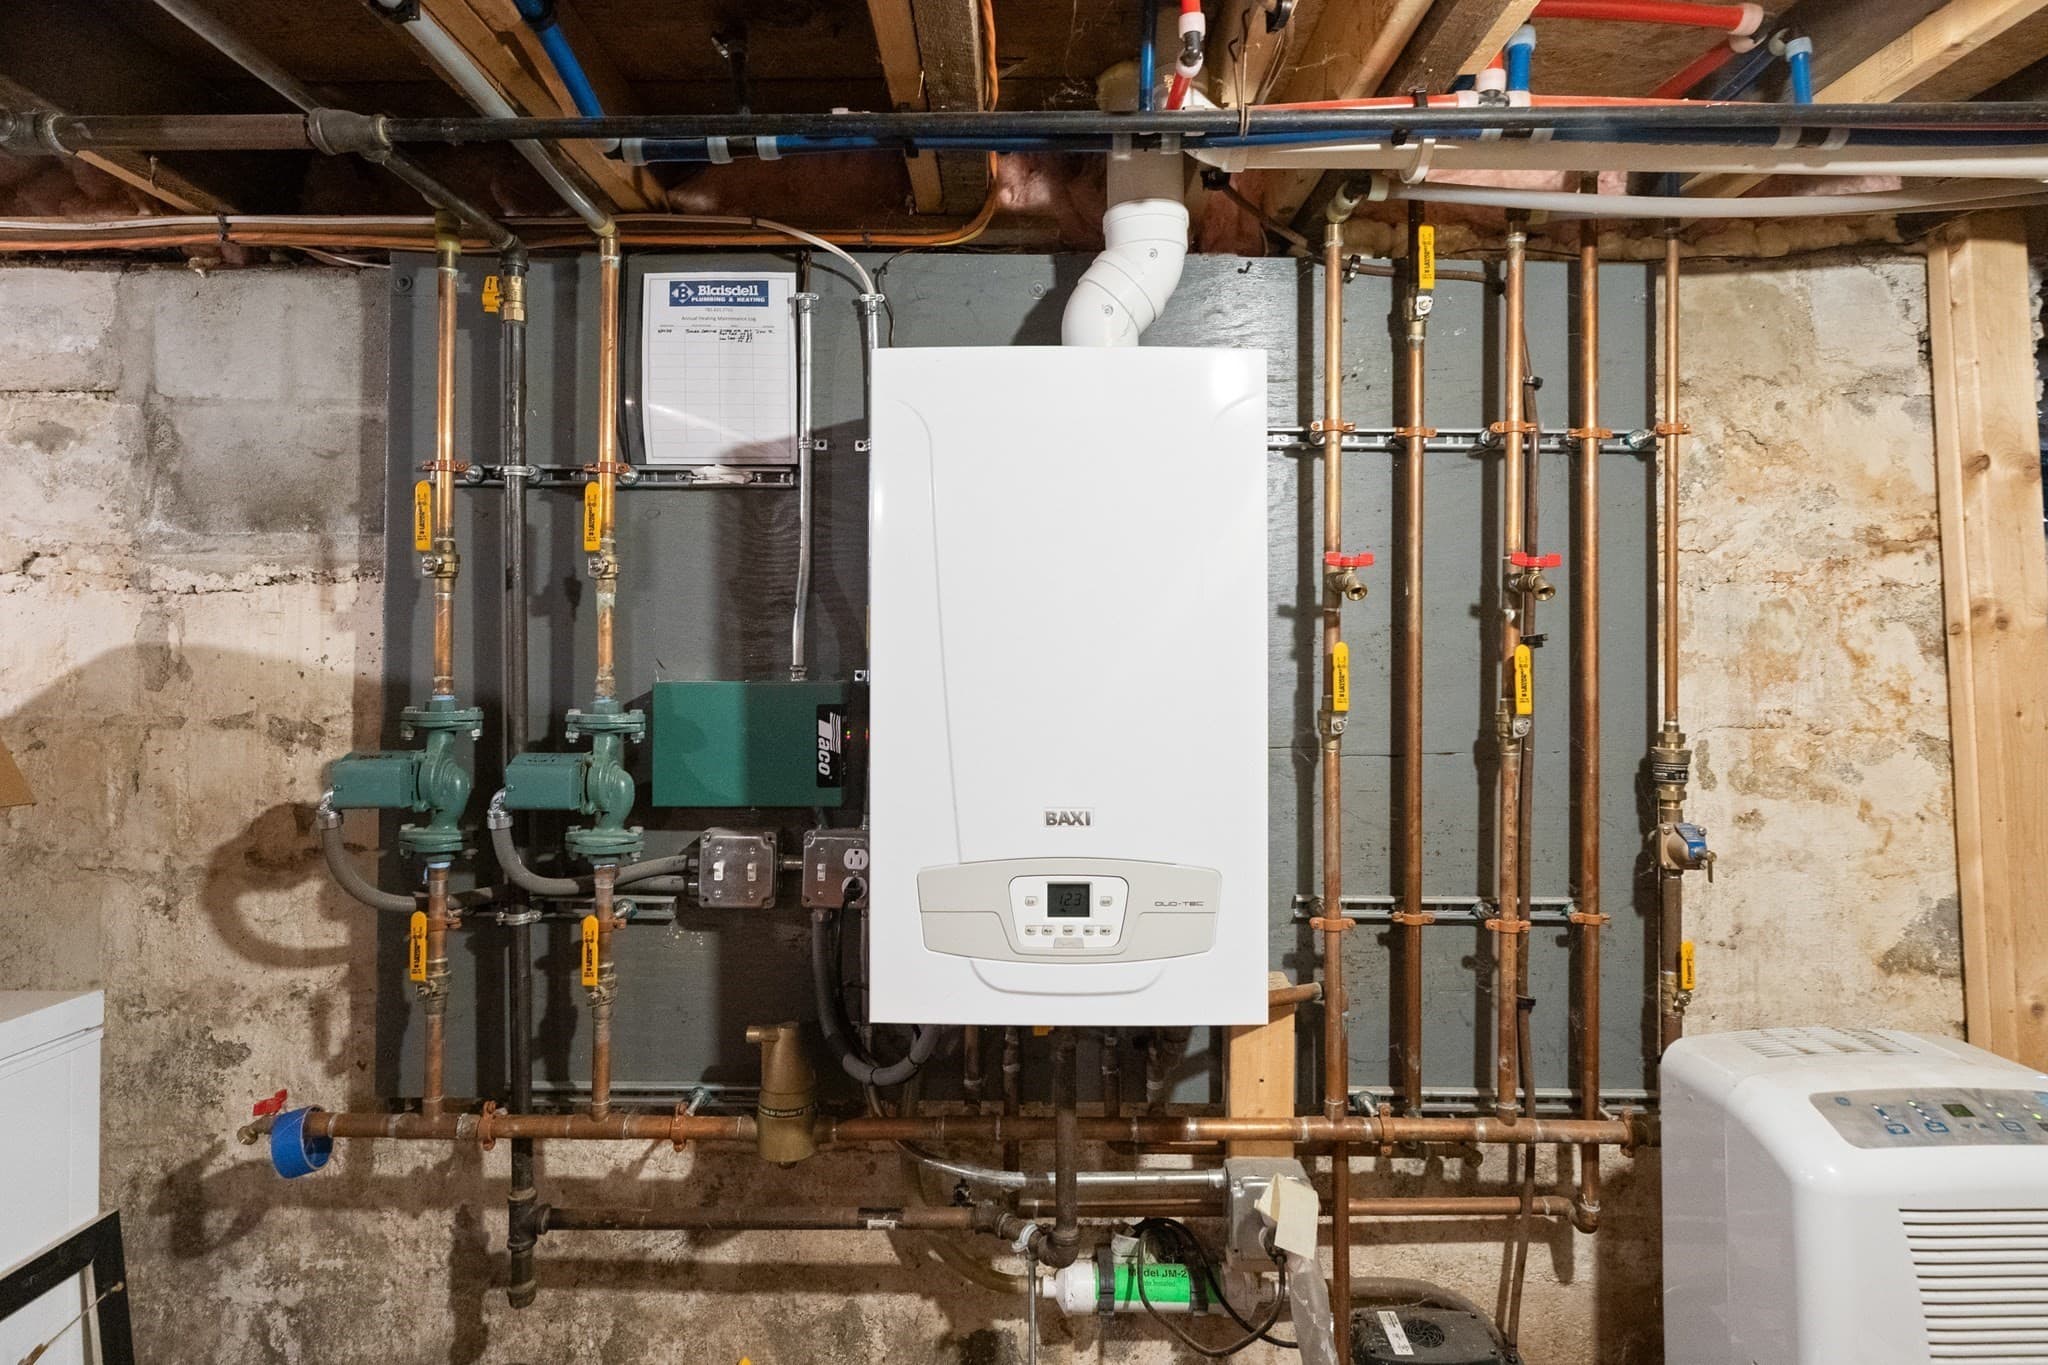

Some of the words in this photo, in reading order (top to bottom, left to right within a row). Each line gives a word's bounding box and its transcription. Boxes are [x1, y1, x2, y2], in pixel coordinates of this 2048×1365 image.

[698, 285, 759, 296] Blaisdell
[818, 711, 841, 777] Taco
[1045, 810, 1091, 826] BAXI
[1128, 1268, 1160, 1277] Mdel
